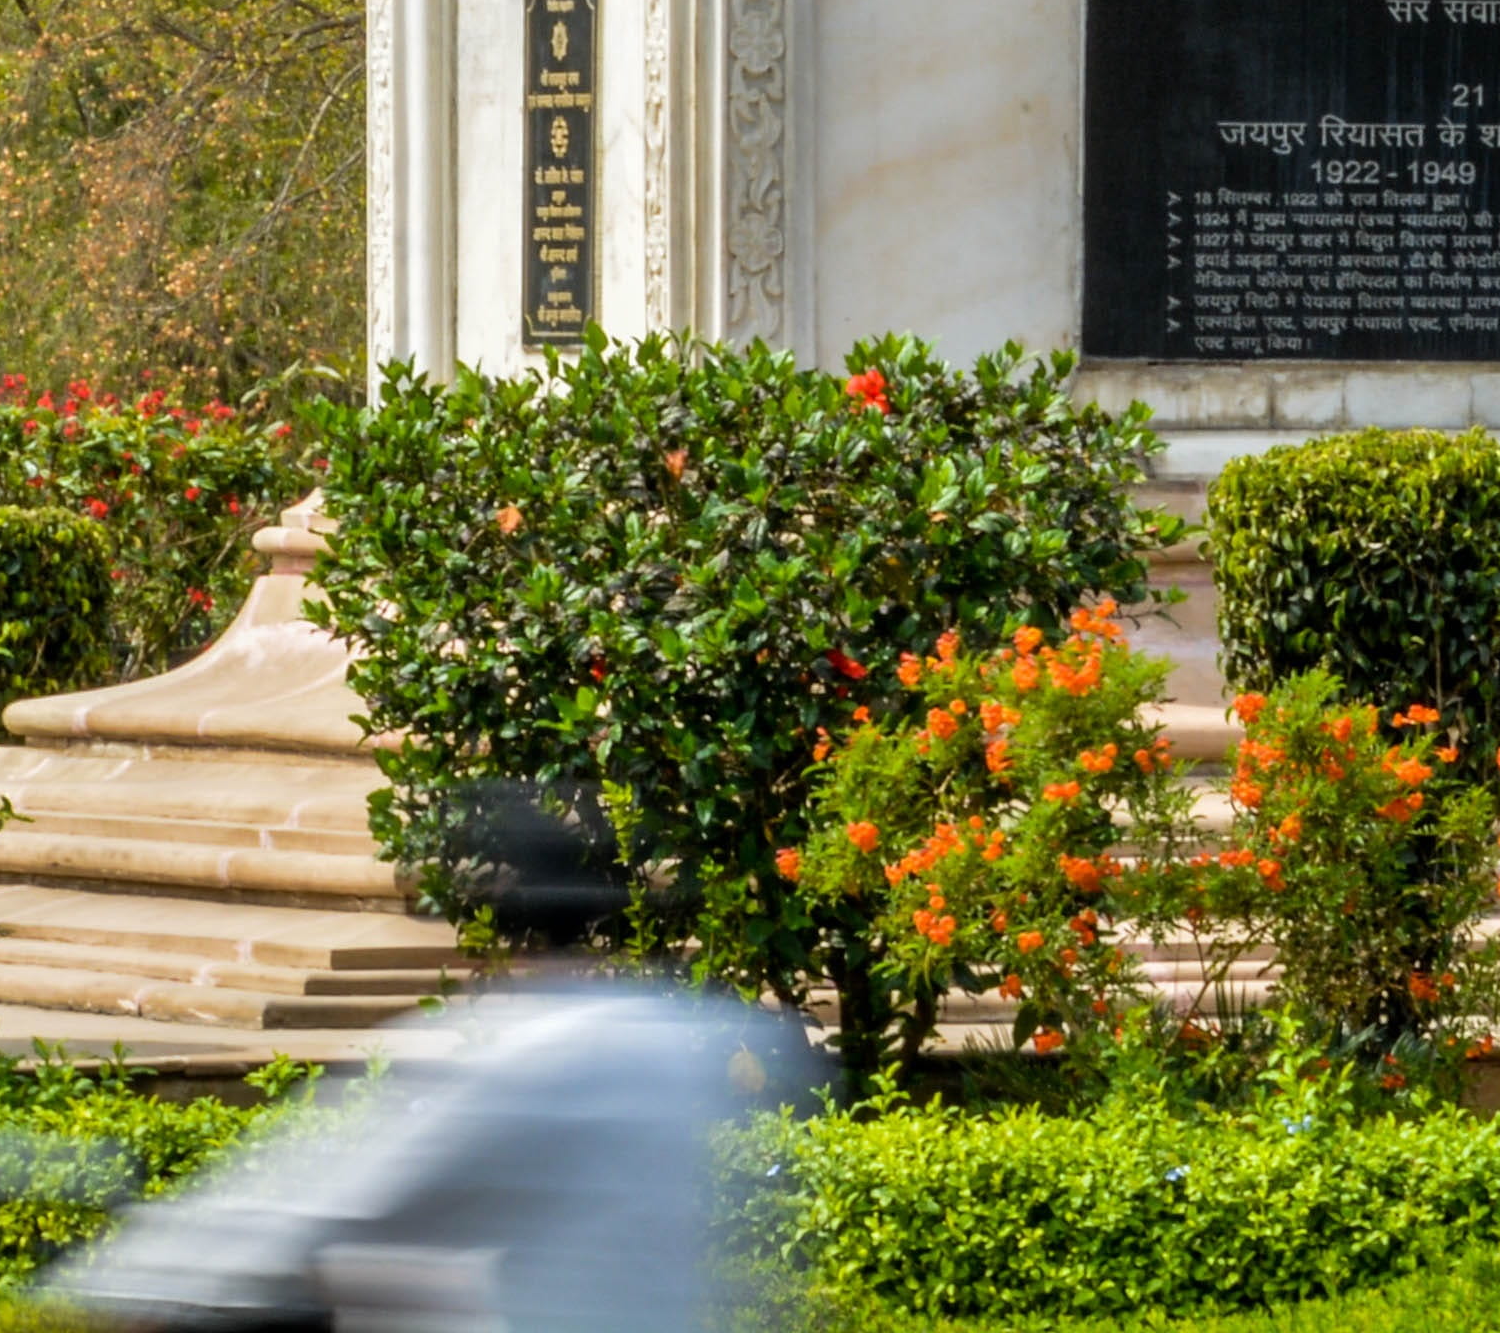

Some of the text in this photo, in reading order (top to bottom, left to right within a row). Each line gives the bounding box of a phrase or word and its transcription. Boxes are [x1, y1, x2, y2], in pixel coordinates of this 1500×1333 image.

[1452, 84, 1484, 108] 21
[1217, 122, 1307, 154] जयपुर
[1318, 114, 1425, 147] रियासत
[1437, 117, 1467, 147] के
[1310, 159, 1380, 184] 1922
[1407, 160, 1477, 184] 1949
[1250, 234, 1294, 251] जयपुर
[1194, 295, 1239, 314] जयपुर
